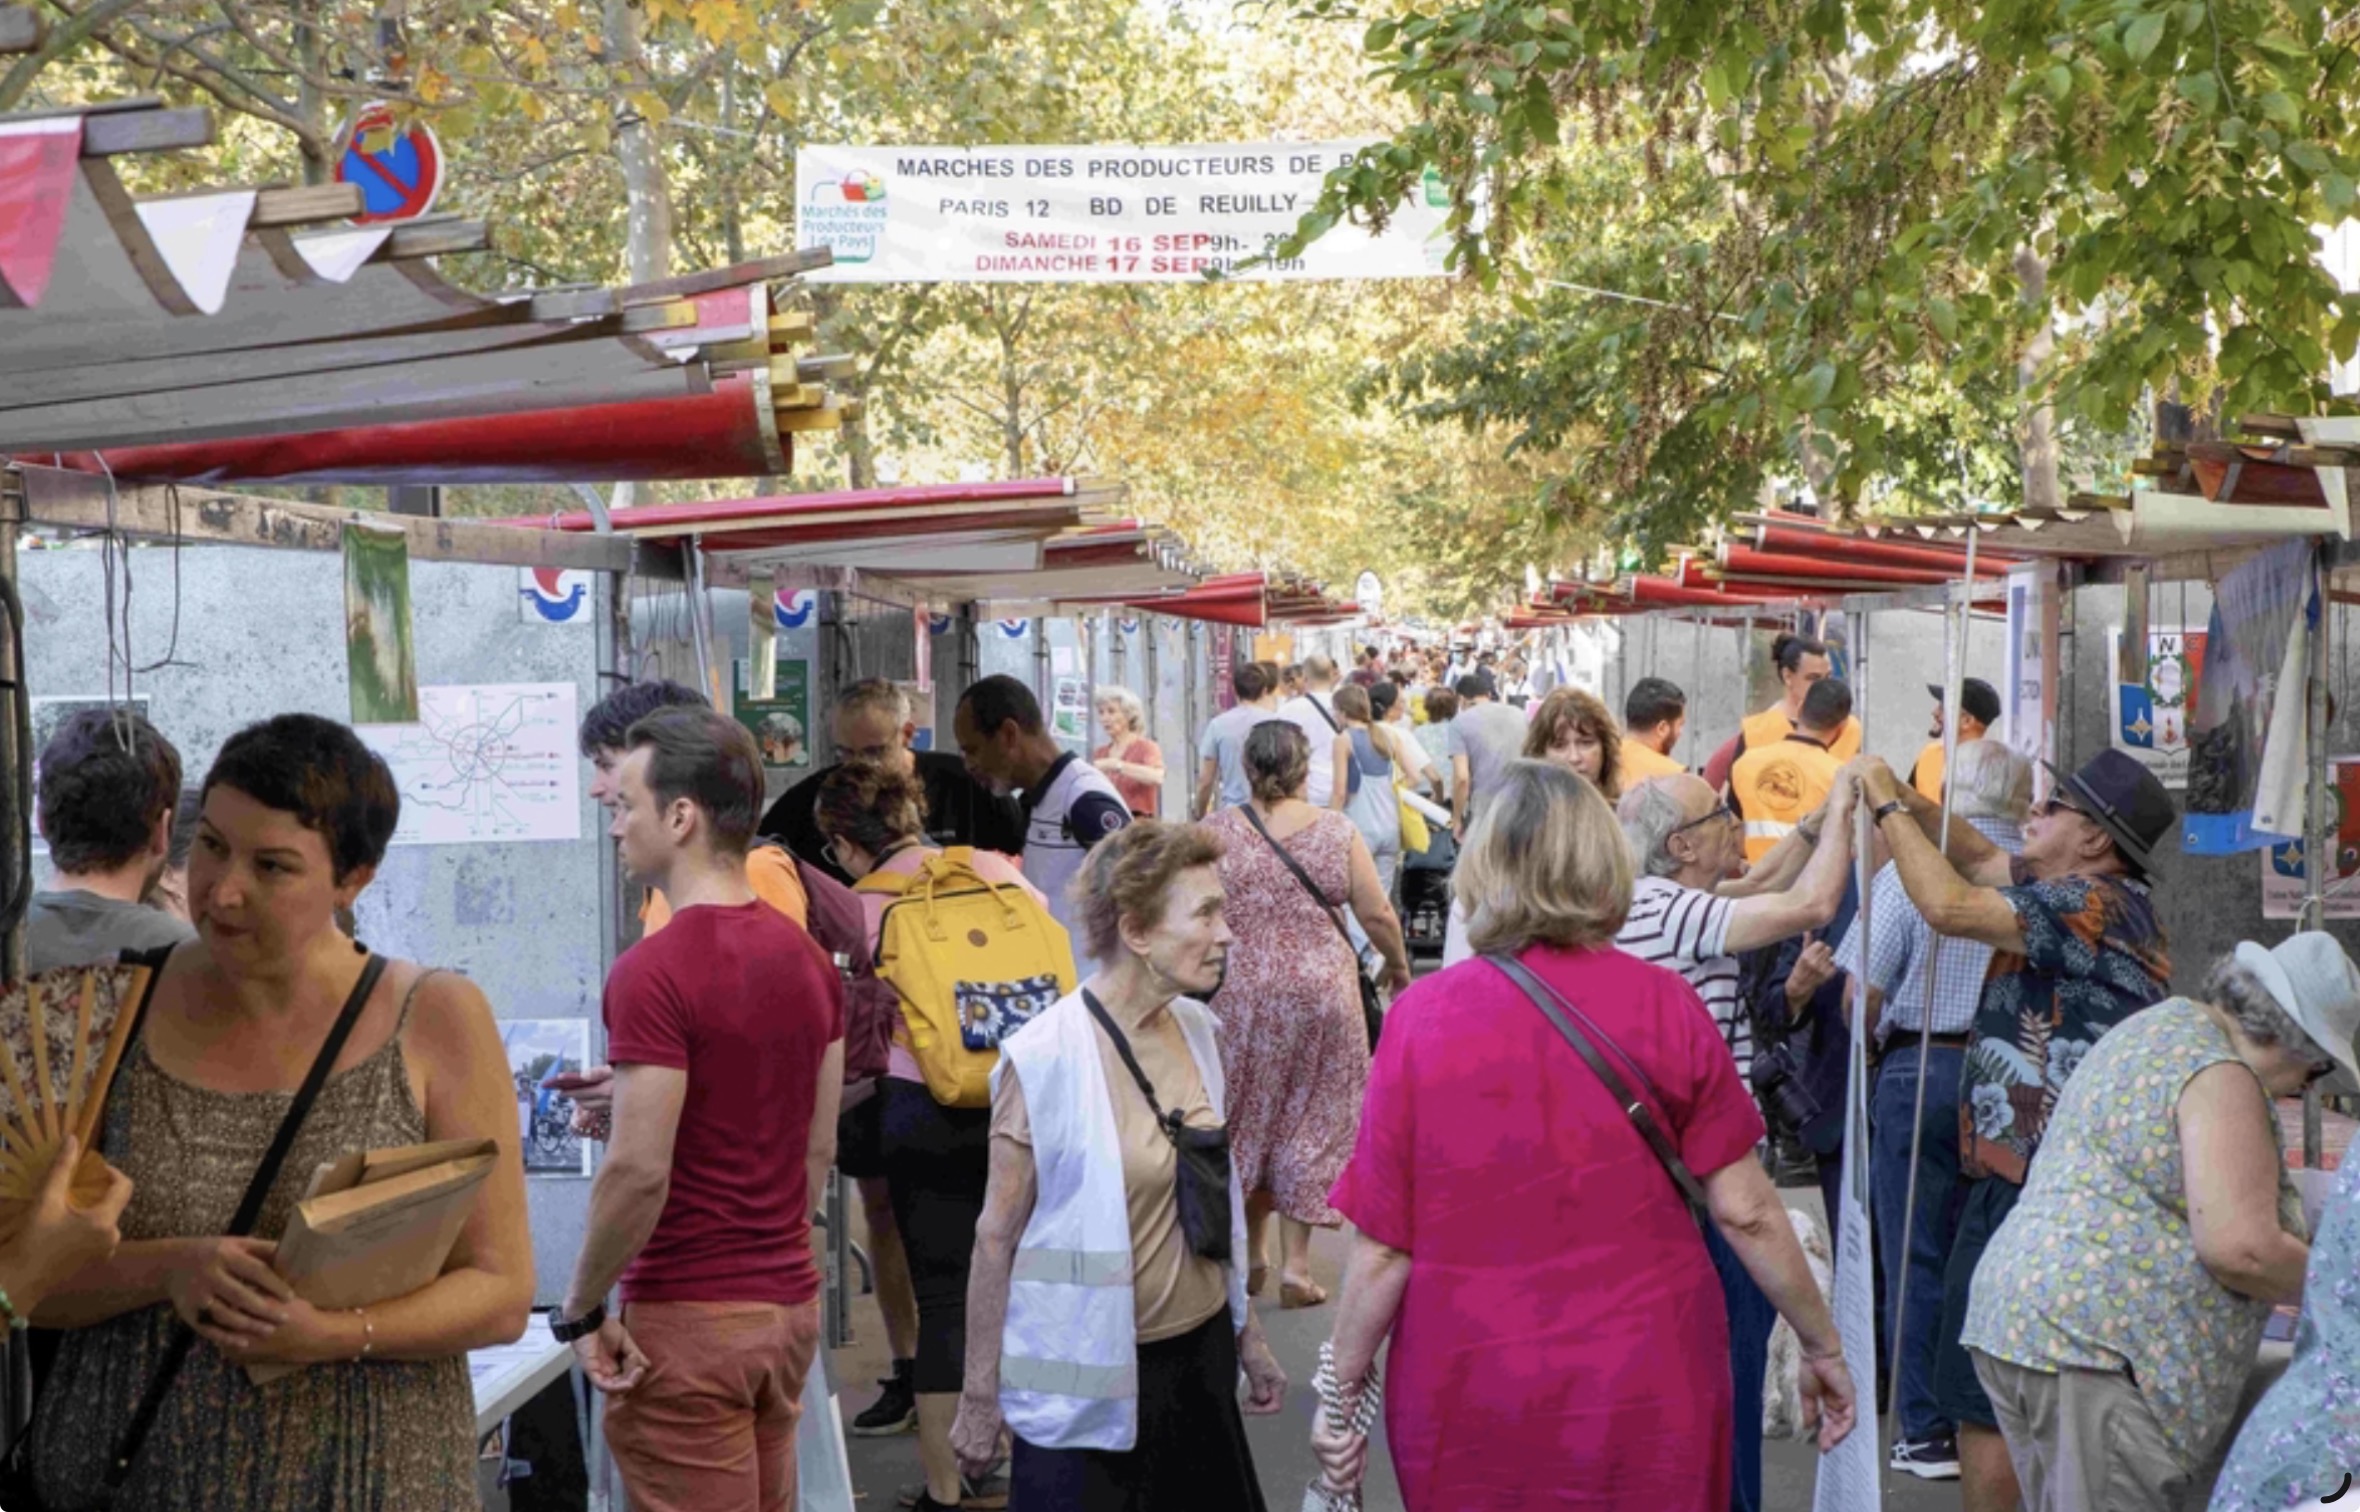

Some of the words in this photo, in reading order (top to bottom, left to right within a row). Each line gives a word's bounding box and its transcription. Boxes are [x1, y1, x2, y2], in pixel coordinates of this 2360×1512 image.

[897, 157, 1013, 177] MARCHES
[1025, 158, 1074, 177] DES
[1087, 156, 1274, 178] PRODUCTEURS
[1289, 154, 1322, 173] DE
[802, 206, 860, 219] Marchés
[863, 206, 888, 219] des
[939, 199, 1009, 218] PARIS
[1025, 199, 1050, 218] 12
[1089, 197, 1122, 216] BD
[1145, 196, 1177, 216] DE
[1200, 194, 1297, 214] REUILLY
[802, 220, 886, 235] Producteurs
[1004, 232, 1096, 249] SAMEDI
[1107, 236, 1142, 252] 16
[1153, 233, 1210, 251] SEP
[976, 254, 1098, 272] DIMANCHE
[1106, 256, 1140, 273] 17
[1152, 256, 1209, 274] SEP
[2159, 637, 2176, 653] N
